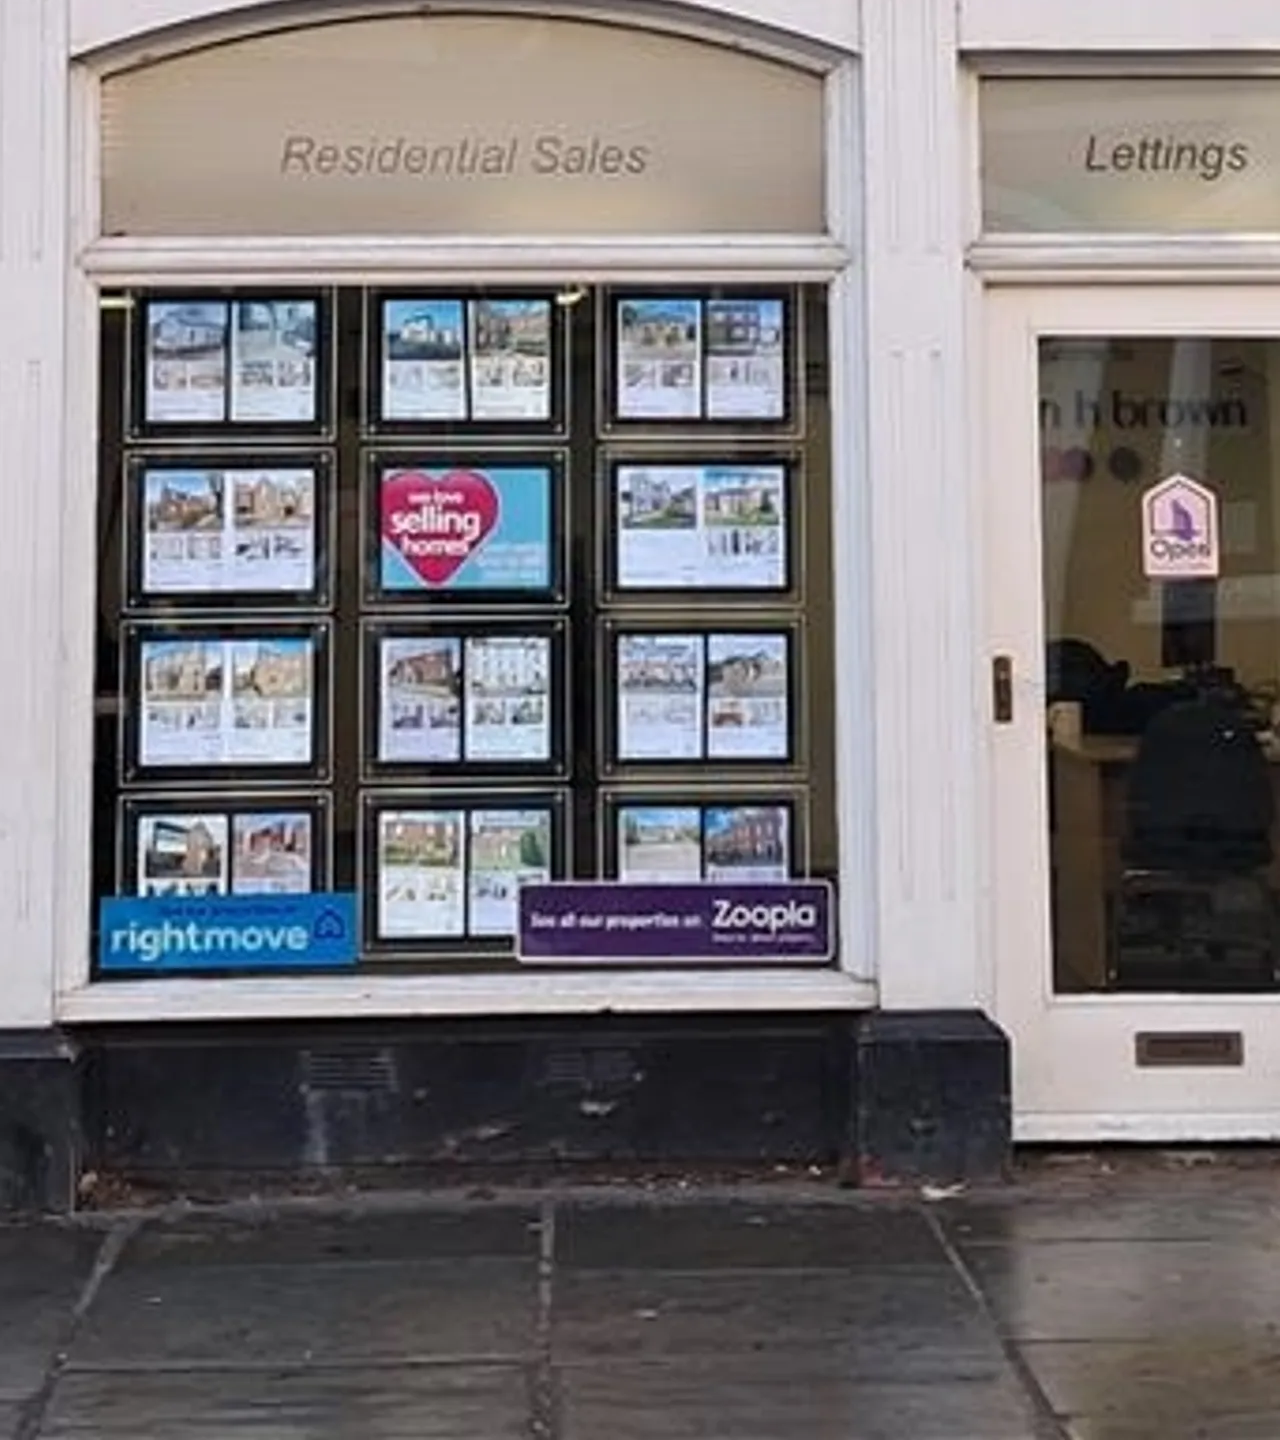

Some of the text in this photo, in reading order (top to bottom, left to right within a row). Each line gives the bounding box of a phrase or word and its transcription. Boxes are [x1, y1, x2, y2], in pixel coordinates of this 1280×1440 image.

[280, 135, 651, 175] Residential Sales
[1084, 134, 1250, 181] Lettings
[1112, 390, 1247, 429] brown
[391, 504, 481, 542] selling
[399, 536, 470, 557] homes
[1150, 539, 1212, 560] Open
[712, 899, 817, 931] Zoopla
[110, 921, 308, 961] rightmove
